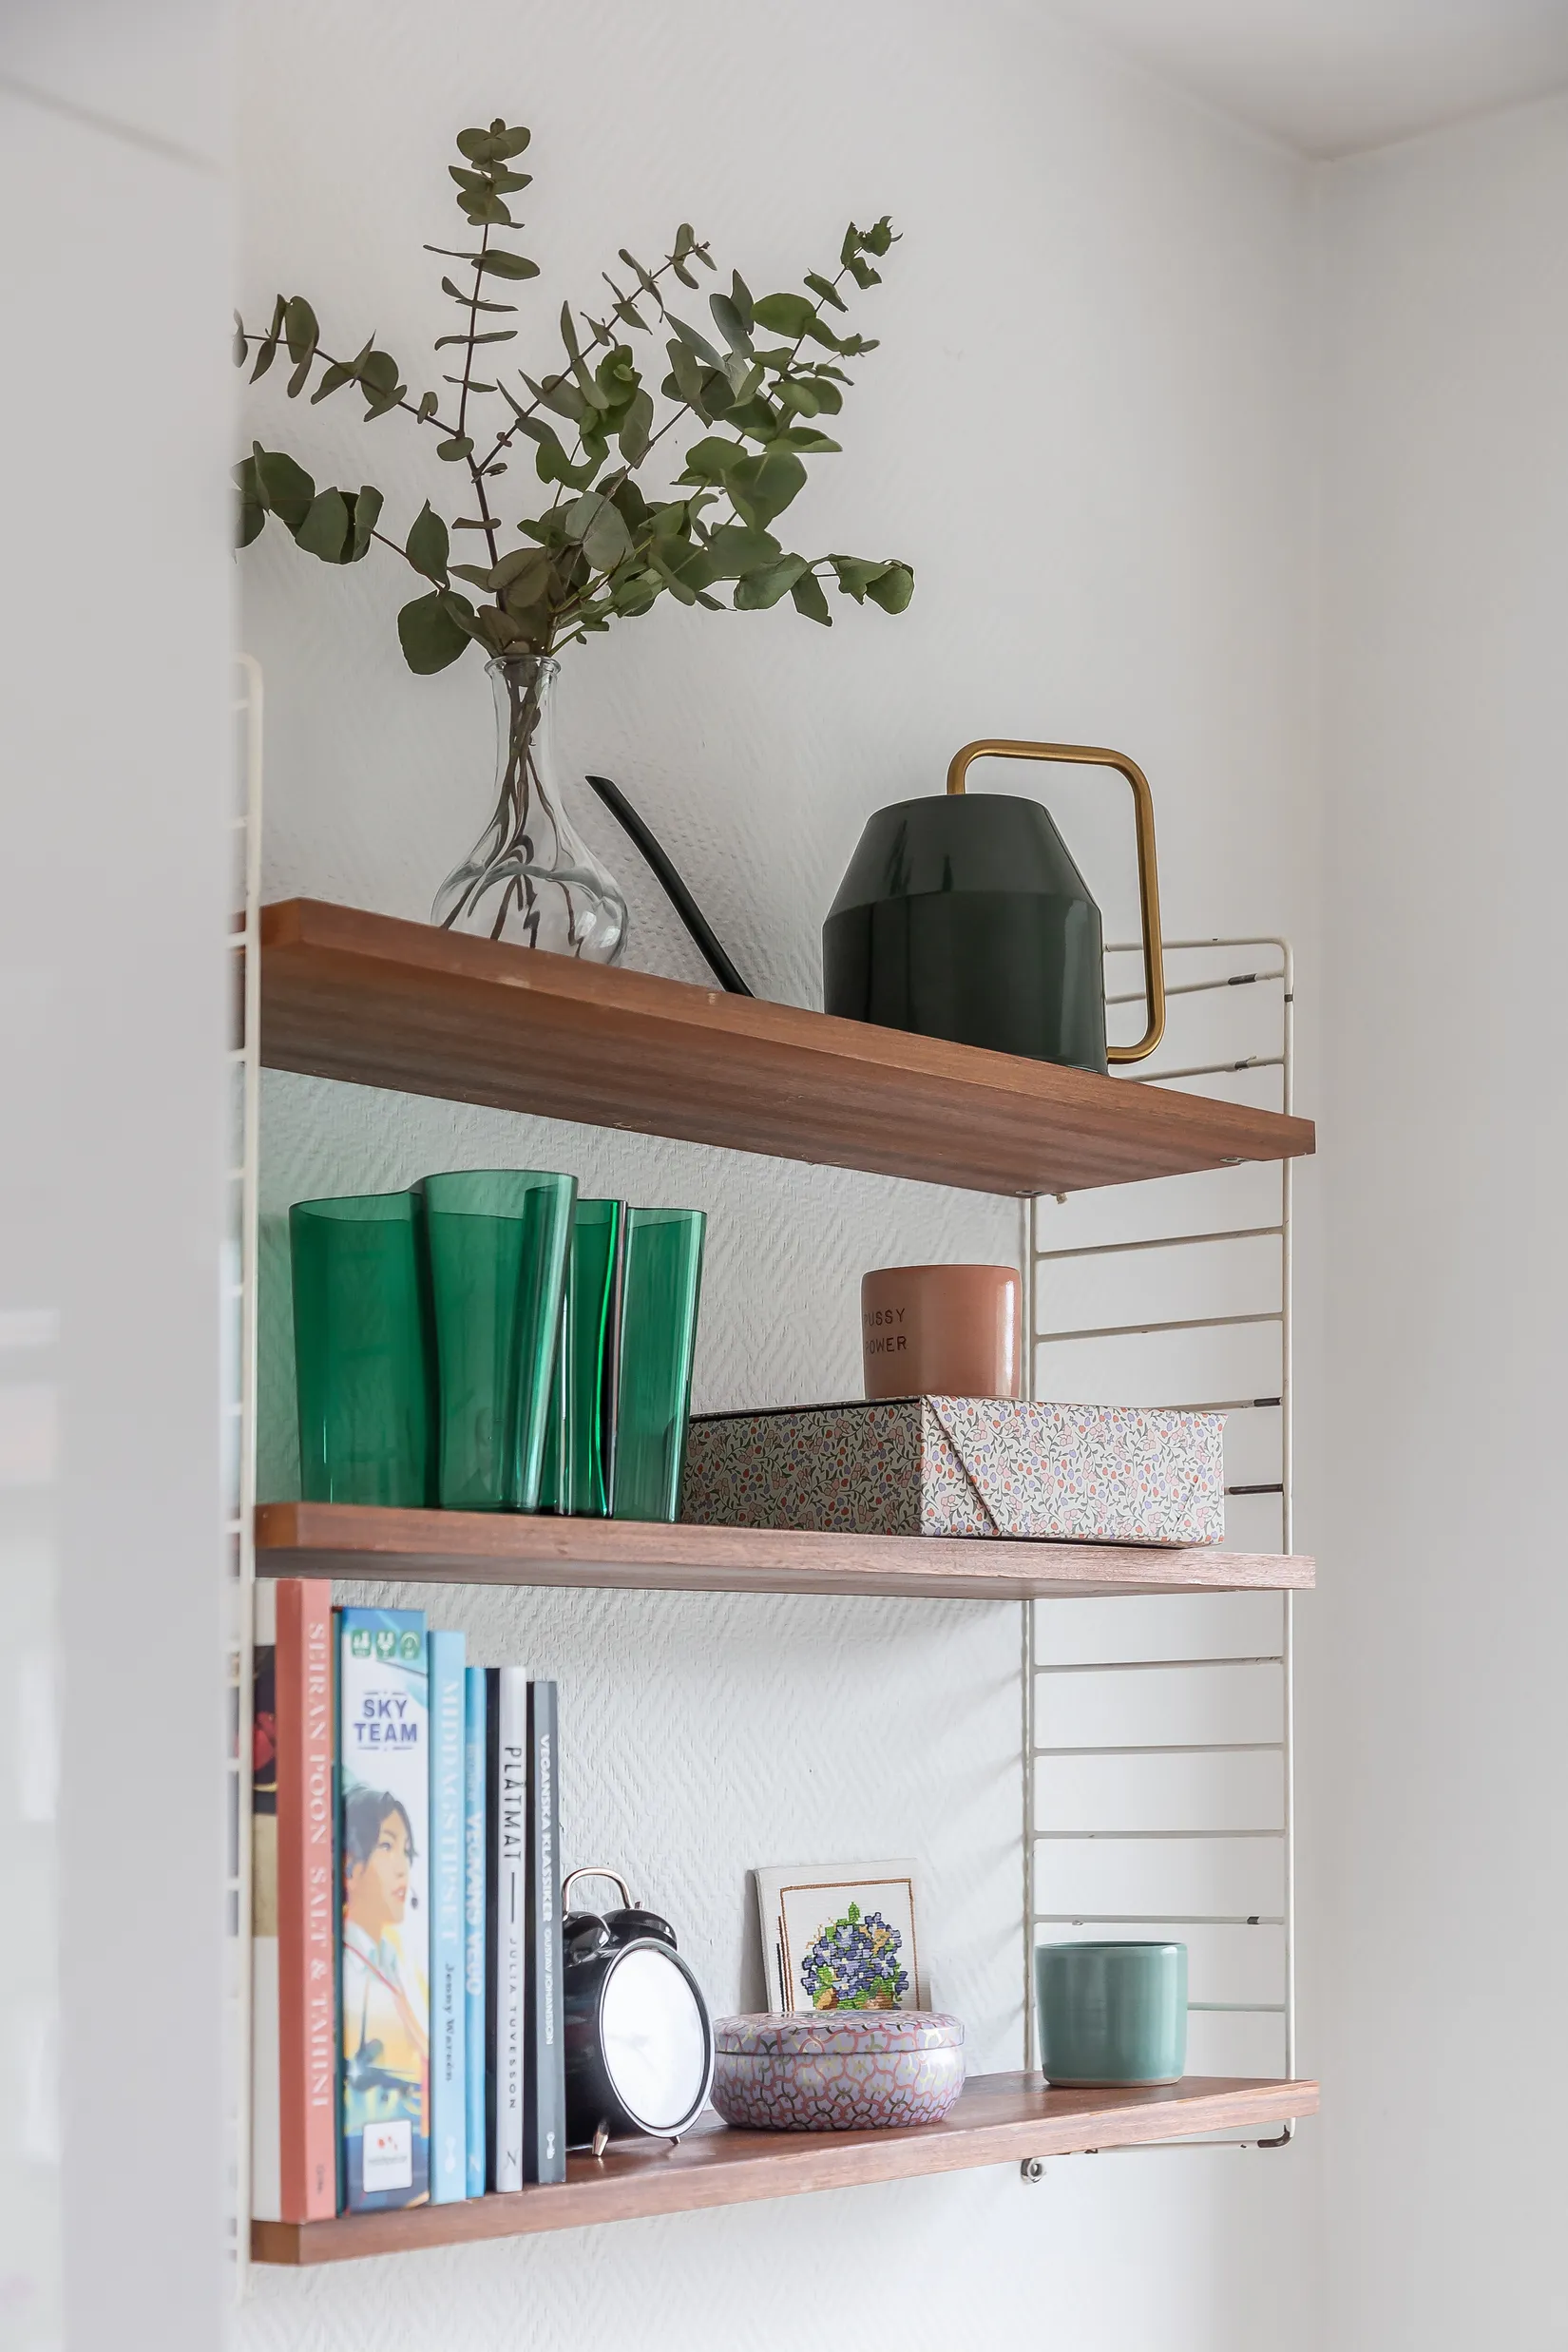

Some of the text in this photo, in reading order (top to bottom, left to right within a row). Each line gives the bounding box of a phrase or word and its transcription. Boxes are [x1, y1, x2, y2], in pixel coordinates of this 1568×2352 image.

[864, 1308, 905, 1327] PUSSY
[866, 1335, 907, 1355] POWER
[354, 1723, 417, 1743] TEAM
[363, 1699, 407, 1718] SKY
[309, 1754, 327, 1844] POON
[310, 1866, 327, 1948] SALT
[540, 1734, 554, 2045] VEGANSKA KLASSIKER GUSTAV JOHANSSON
[504, 1747, 525, 2109] PLÅTMAT JULIA TUVESSON
[311, 1958, 327, 1980] &
[311, 1991, 329, 2107] TAHINI
